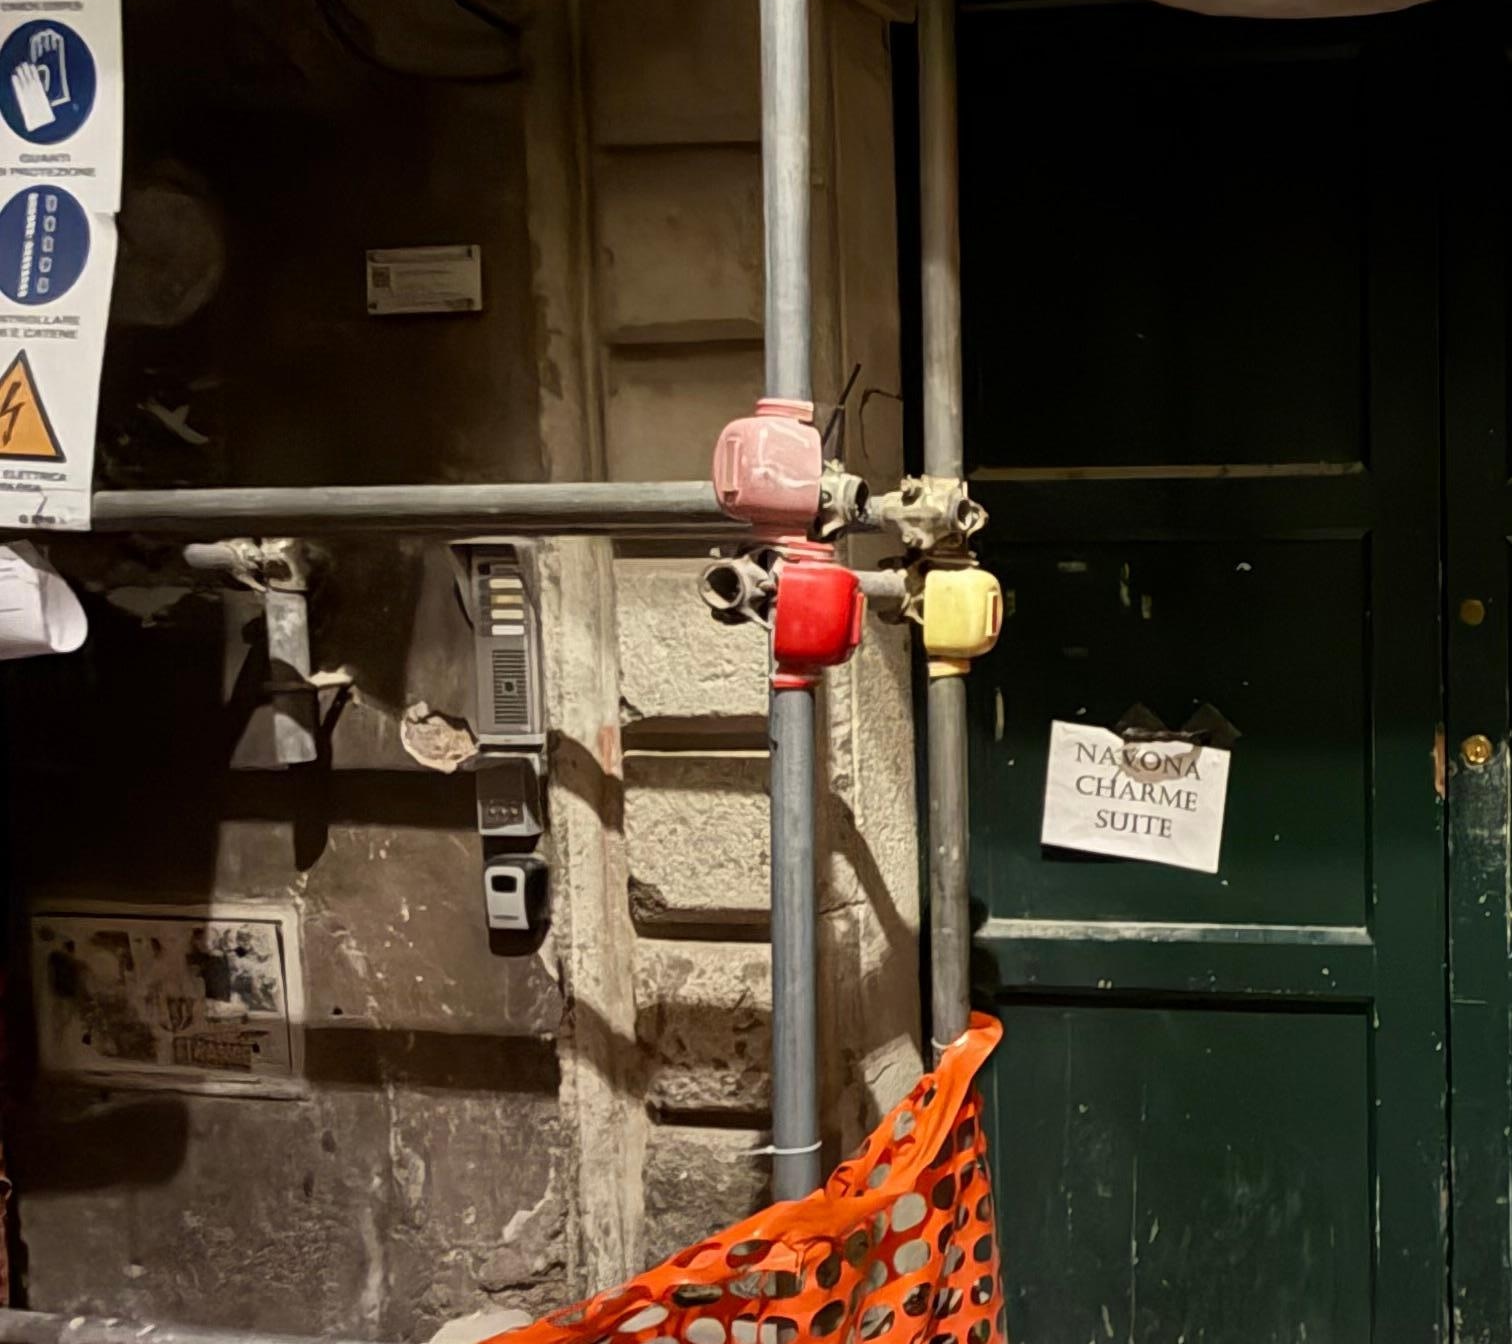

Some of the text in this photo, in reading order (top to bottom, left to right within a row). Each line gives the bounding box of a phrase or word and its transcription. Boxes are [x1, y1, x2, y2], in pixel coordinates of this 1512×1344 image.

[1075, 741, 1202, 781] NAVONA
[1075, 775, 1199, 812] CHARME
[1095, 808, 1173, 839] SUITE
